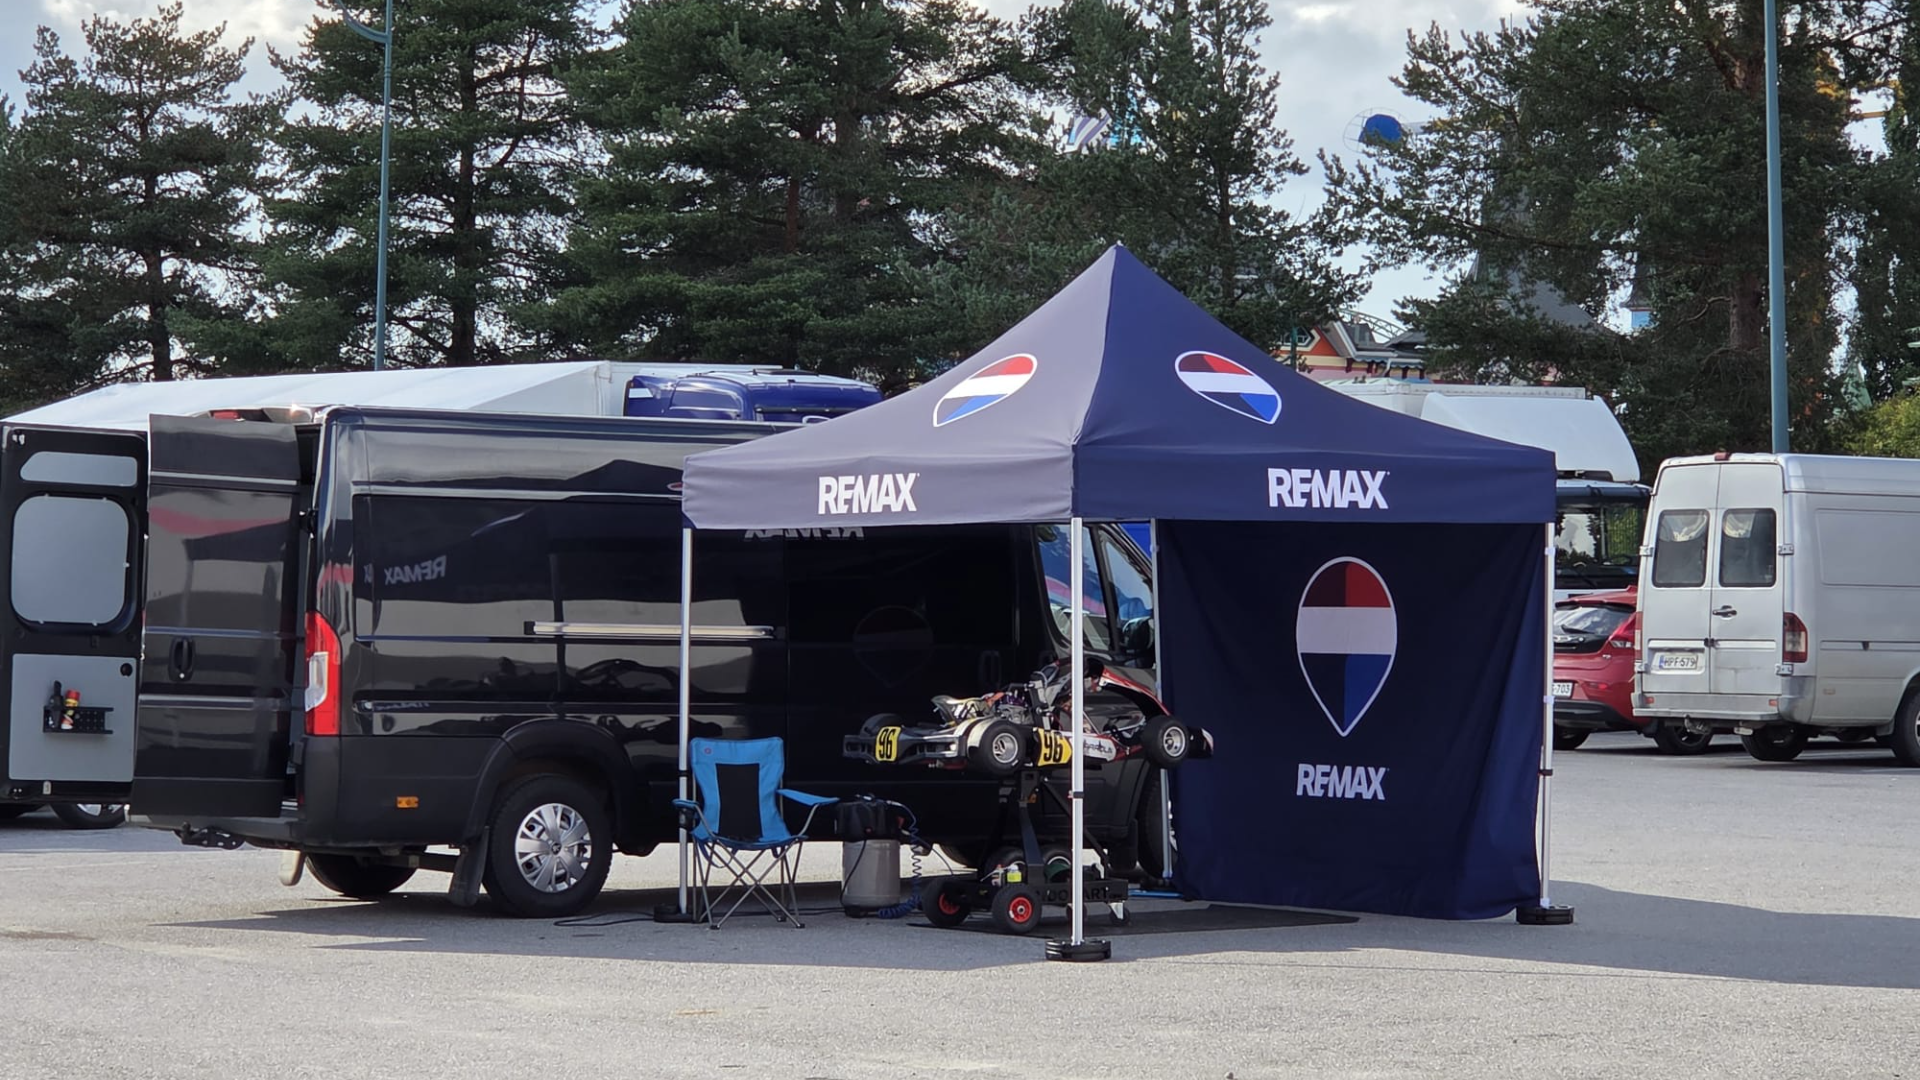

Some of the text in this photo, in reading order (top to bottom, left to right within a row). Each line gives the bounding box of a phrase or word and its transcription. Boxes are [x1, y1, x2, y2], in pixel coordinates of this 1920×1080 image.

[818, 472, 919, 515] REMAX
[1267, 467, 1389, 509] REMAX
[878, 728, 894, 759] 96
[1043, 733, 1064, 763] 96
[1296, 763, 1389, 801] REMAX
